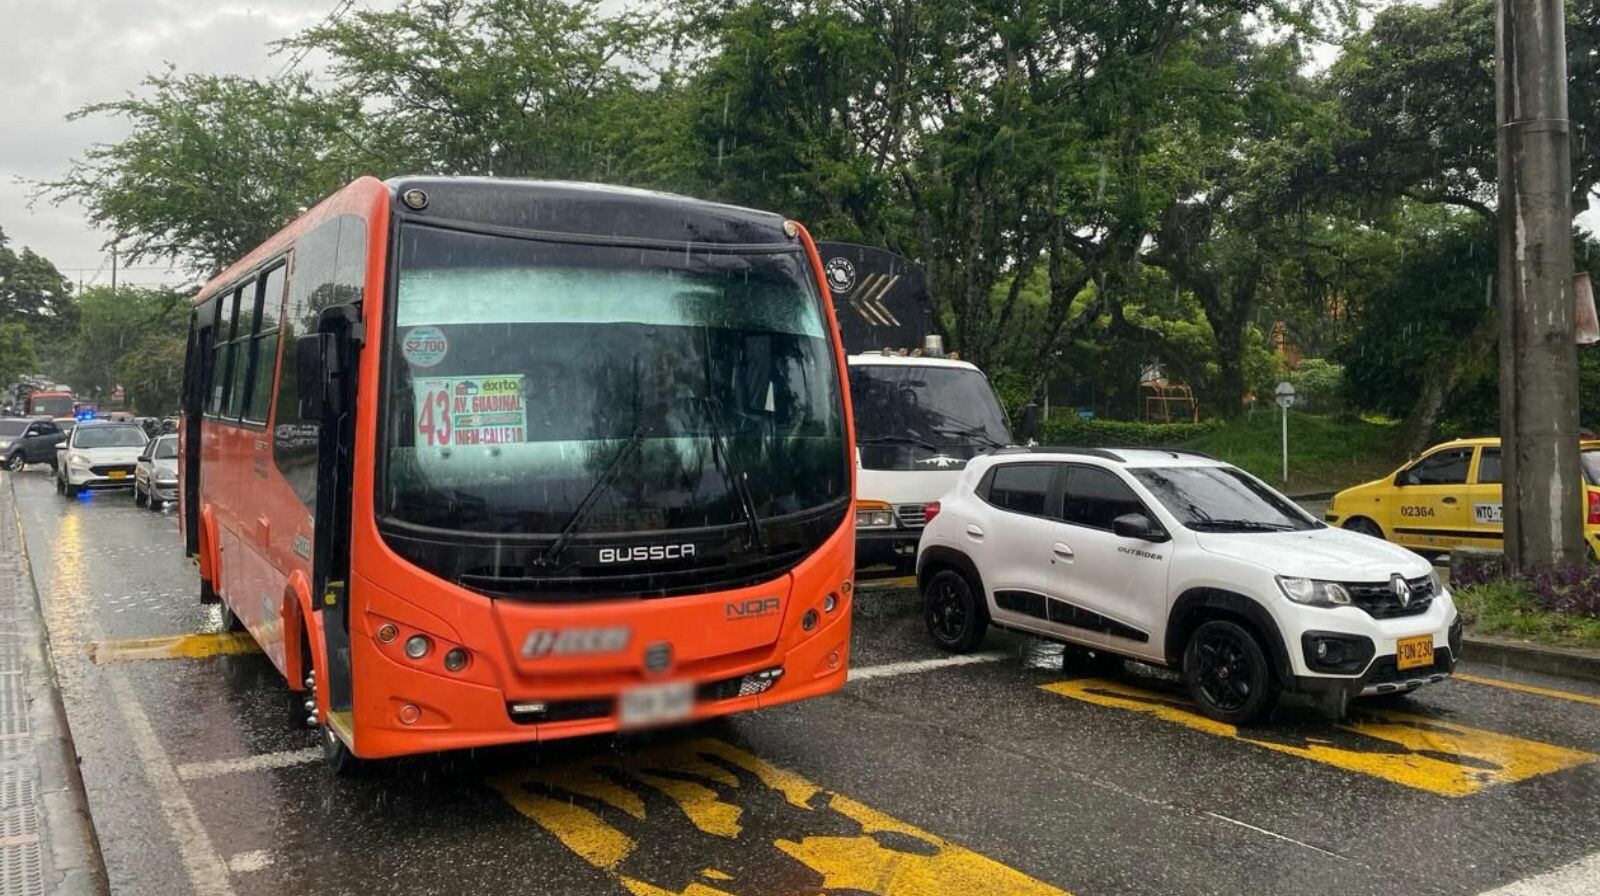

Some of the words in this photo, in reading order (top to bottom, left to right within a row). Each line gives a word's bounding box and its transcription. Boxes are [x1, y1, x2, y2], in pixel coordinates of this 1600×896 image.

[419, 391, 451, 446] 43
[600, 544, 695, 563] BUSSCA
[1117, 546, 1163, 560] OUTSIDER
